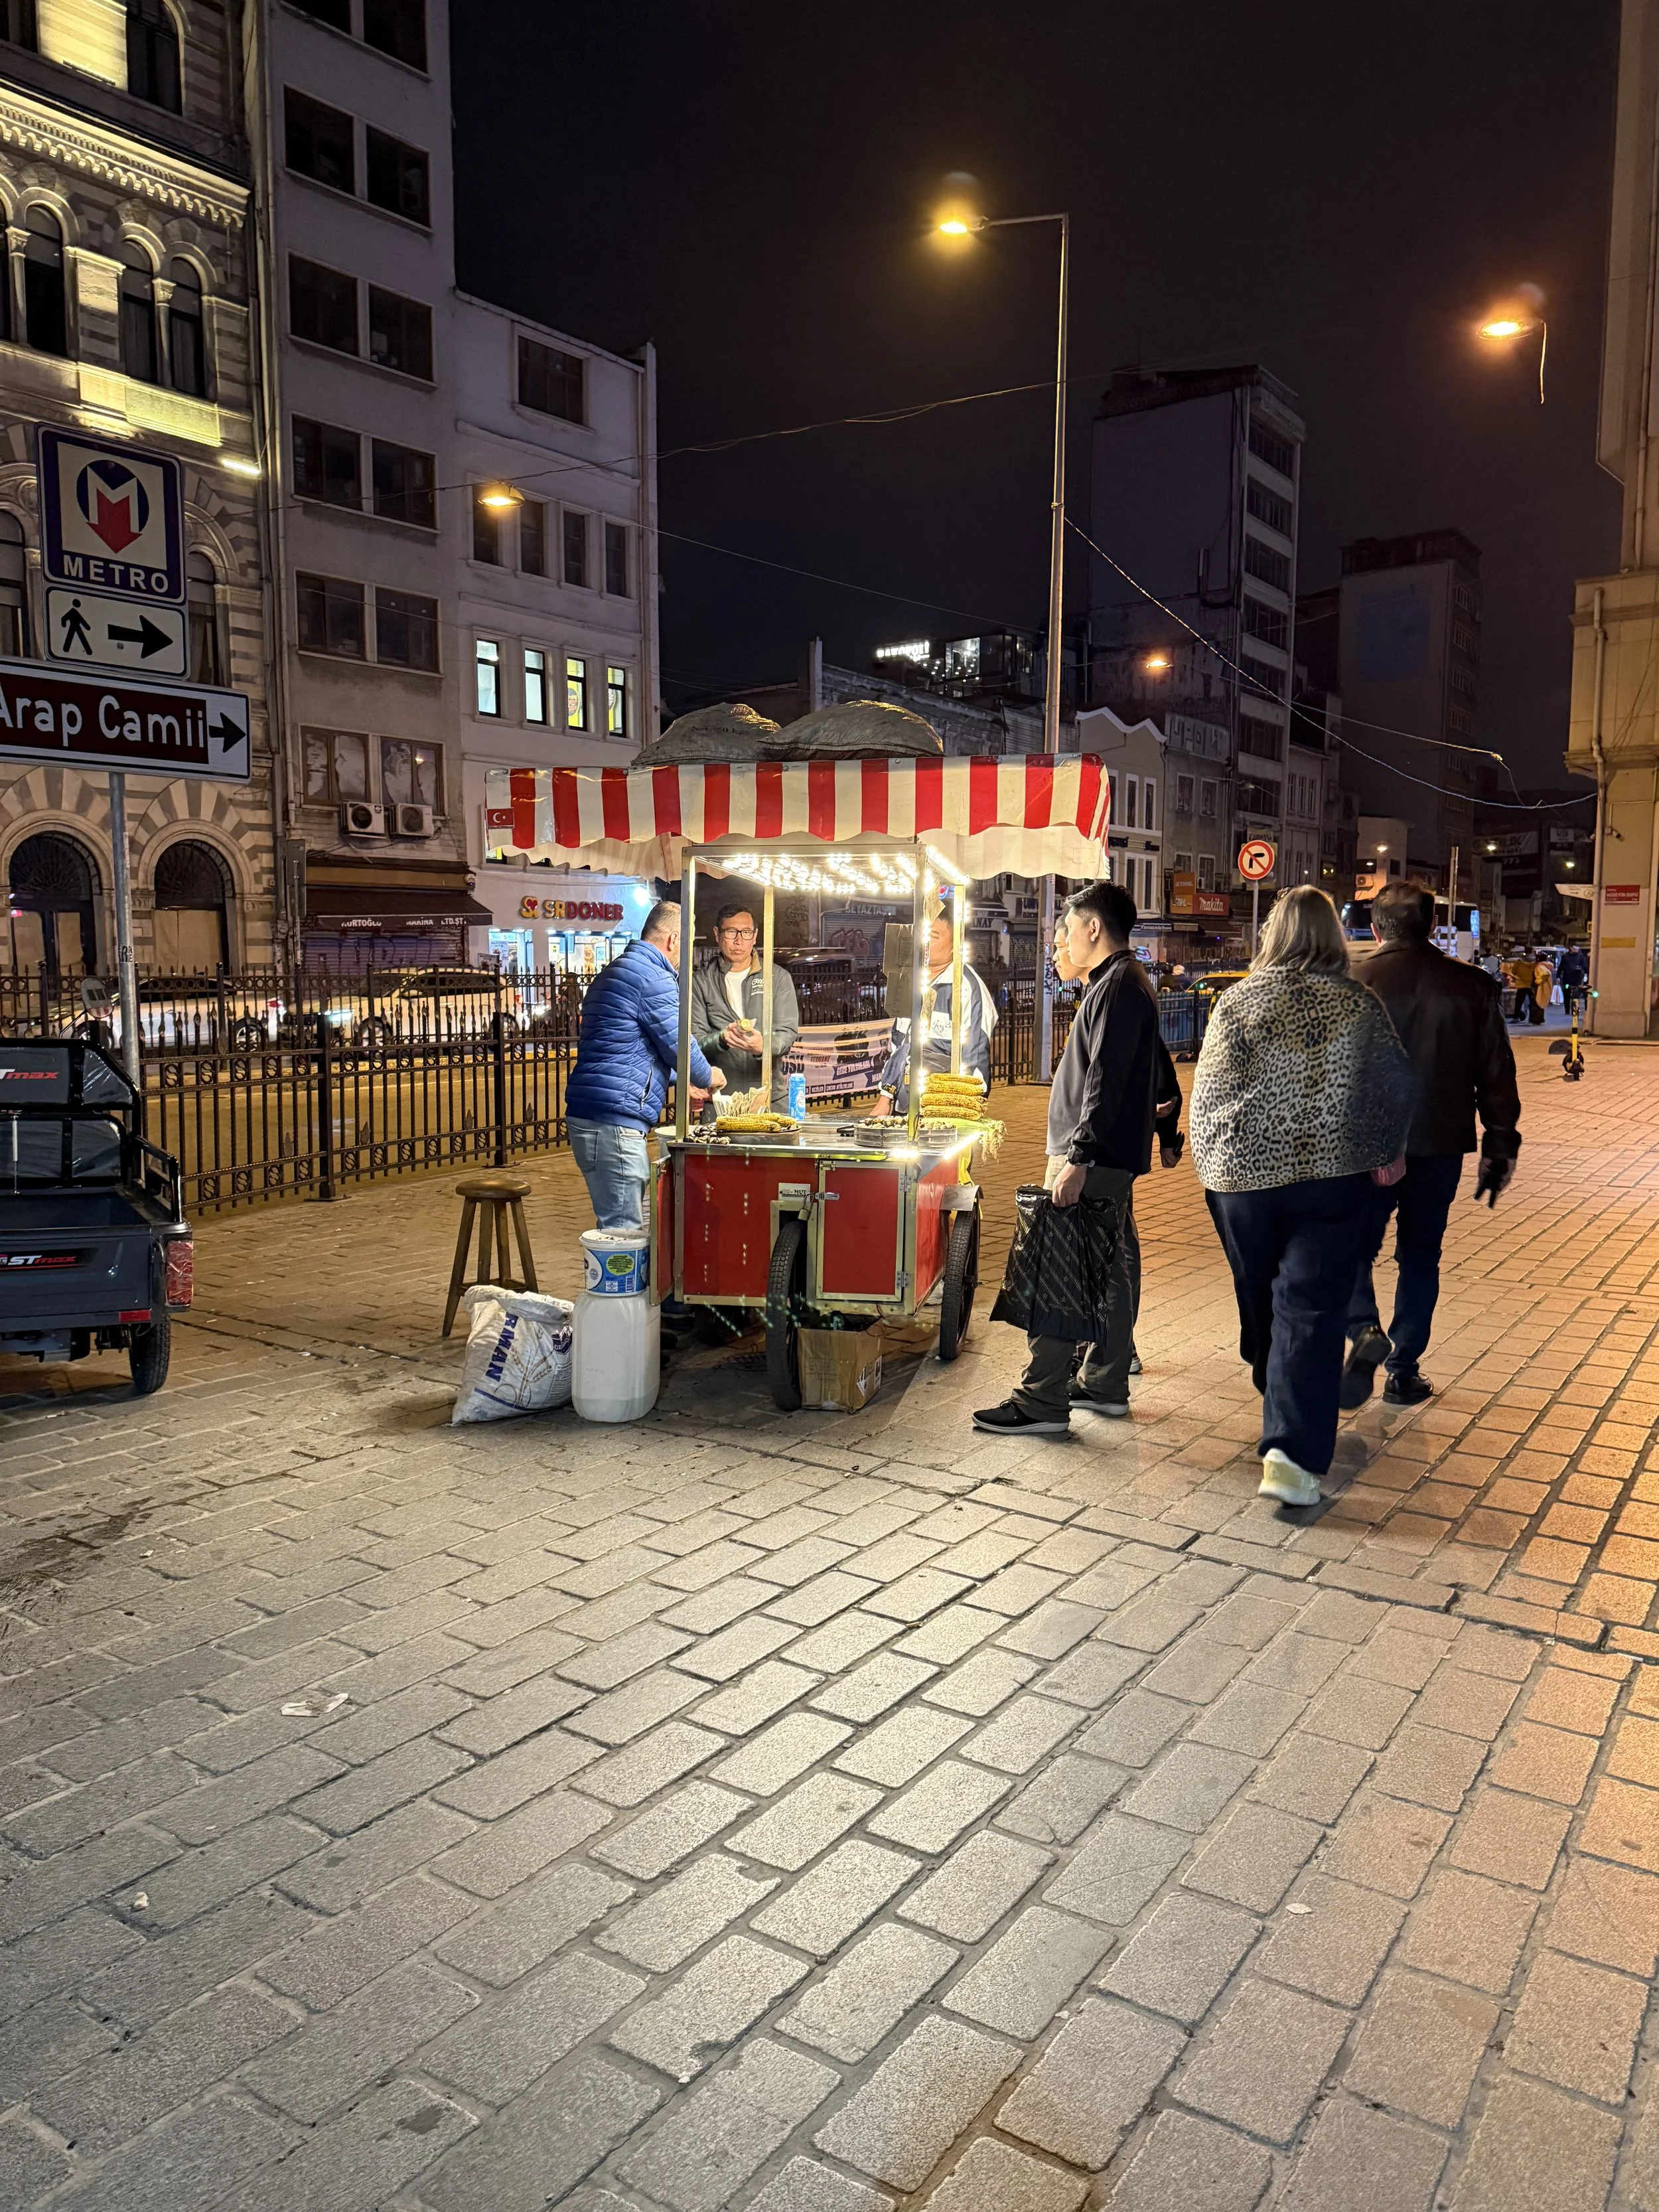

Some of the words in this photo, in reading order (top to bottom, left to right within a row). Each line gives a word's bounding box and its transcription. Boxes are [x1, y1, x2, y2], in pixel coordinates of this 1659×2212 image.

[63, 554, 169, 595] METRO
[98, 694, 205, 749] Camii
[1198, 897, 1224, 912] Makita
